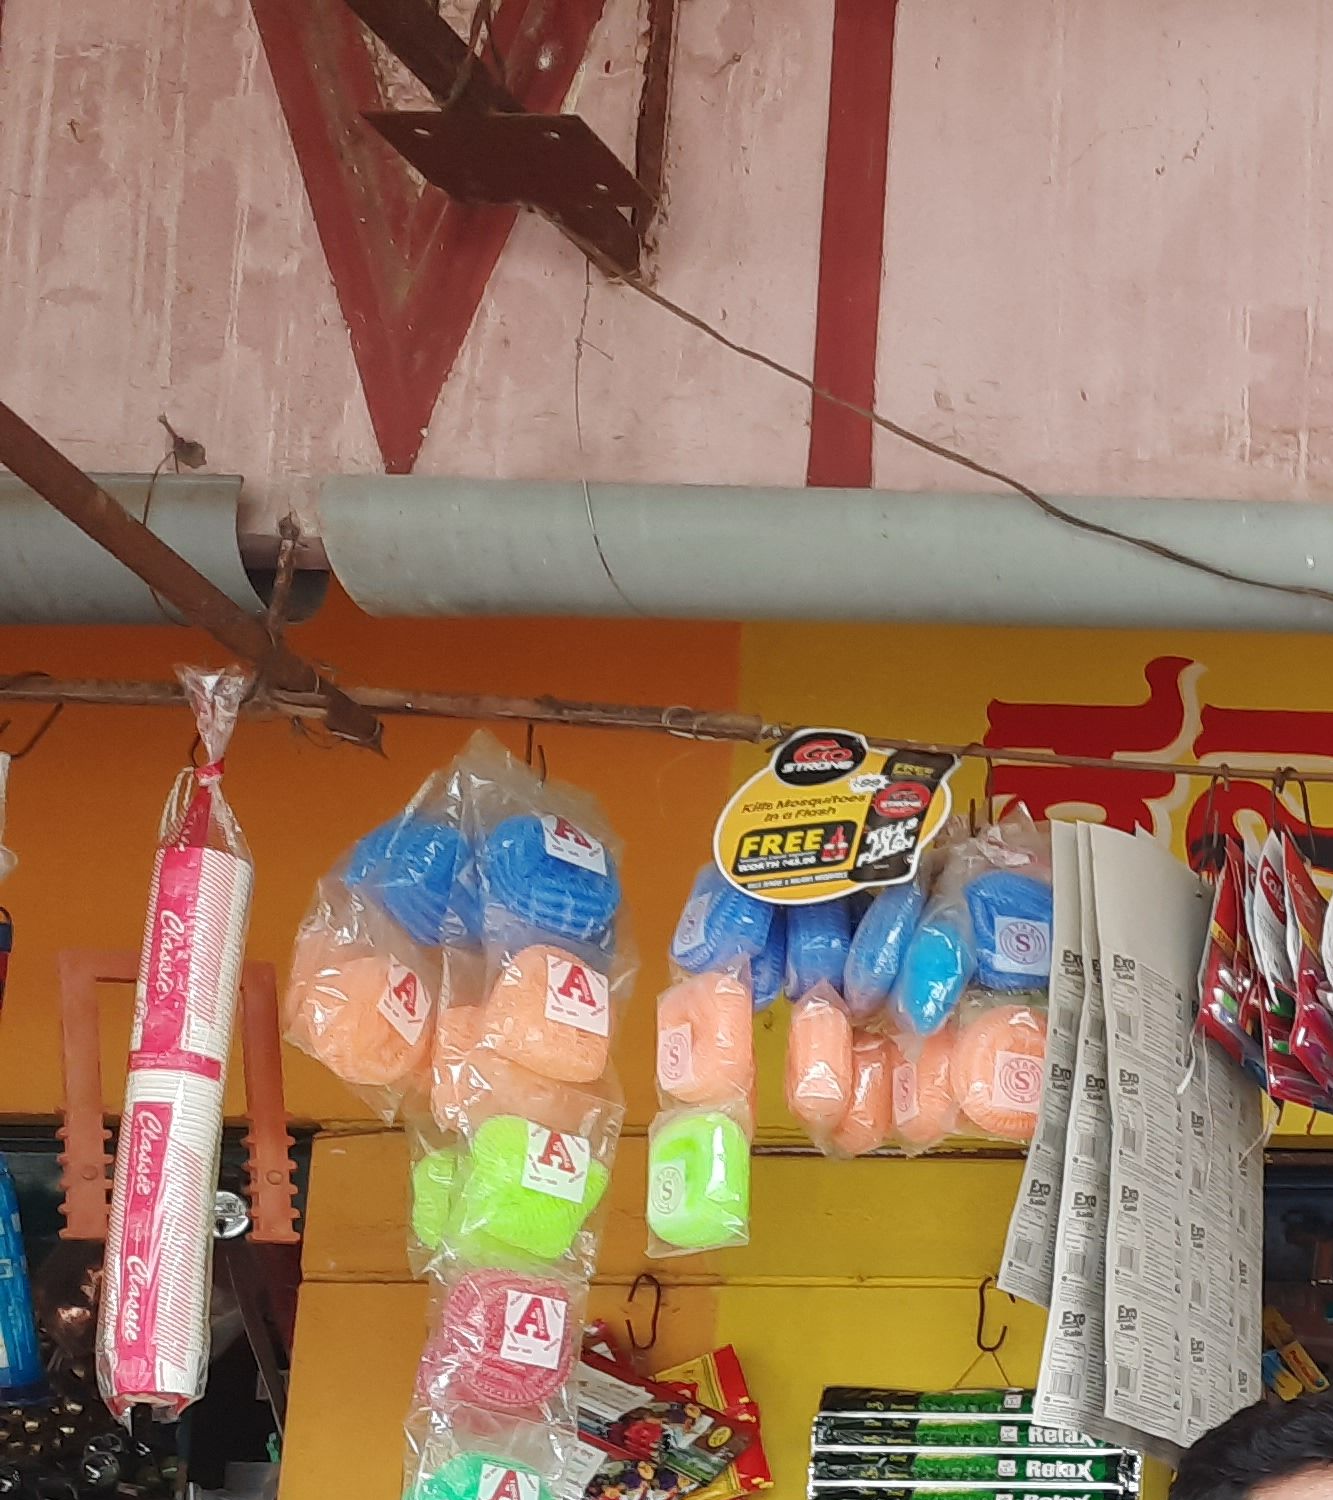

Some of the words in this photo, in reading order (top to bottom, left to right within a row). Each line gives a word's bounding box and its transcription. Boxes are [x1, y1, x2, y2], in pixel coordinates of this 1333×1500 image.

[740, 828, 825, 859] FREE
[1028, 1427, 1096, 1447] Relax
[1026, 1459, 1094, 1481] Relax
